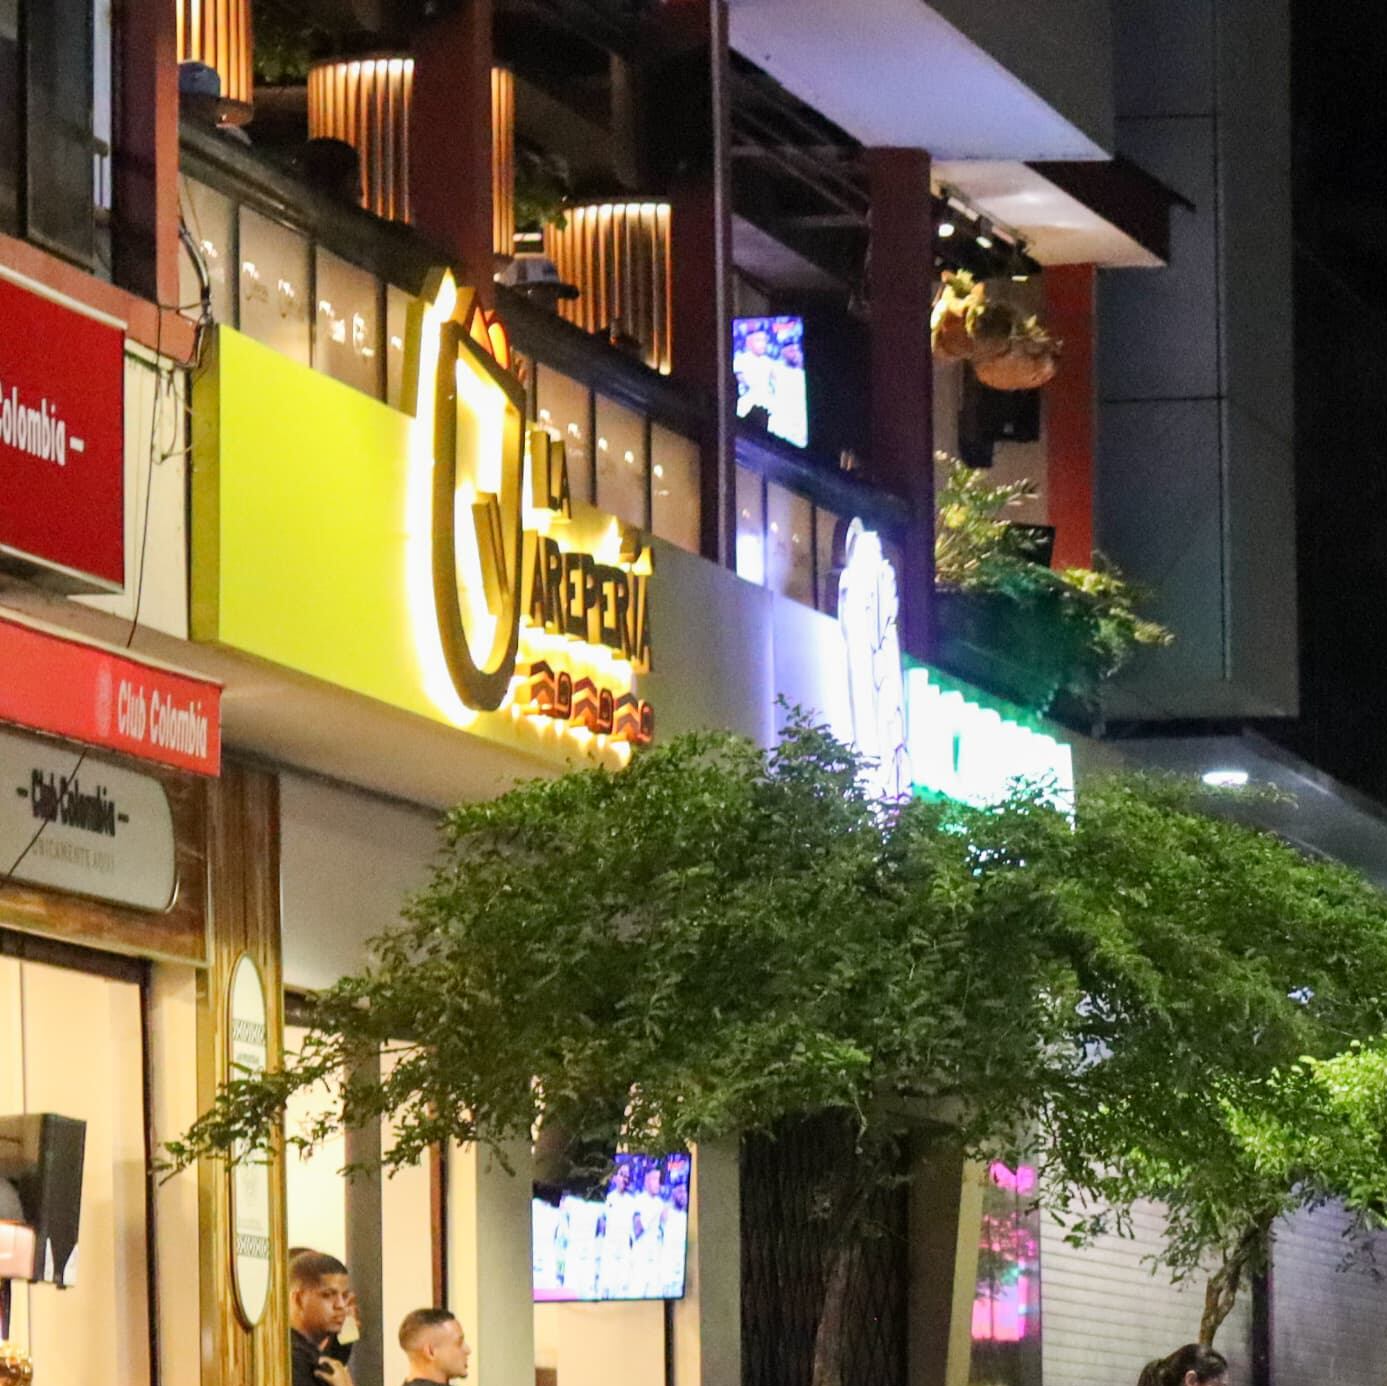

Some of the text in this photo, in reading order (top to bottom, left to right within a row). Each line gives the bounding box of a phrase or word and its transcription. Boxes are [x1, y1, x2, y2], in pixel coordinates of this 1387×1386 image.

[0, 380, 66, 467] olombia
[117, 679, 208, 759] Club Colombia
